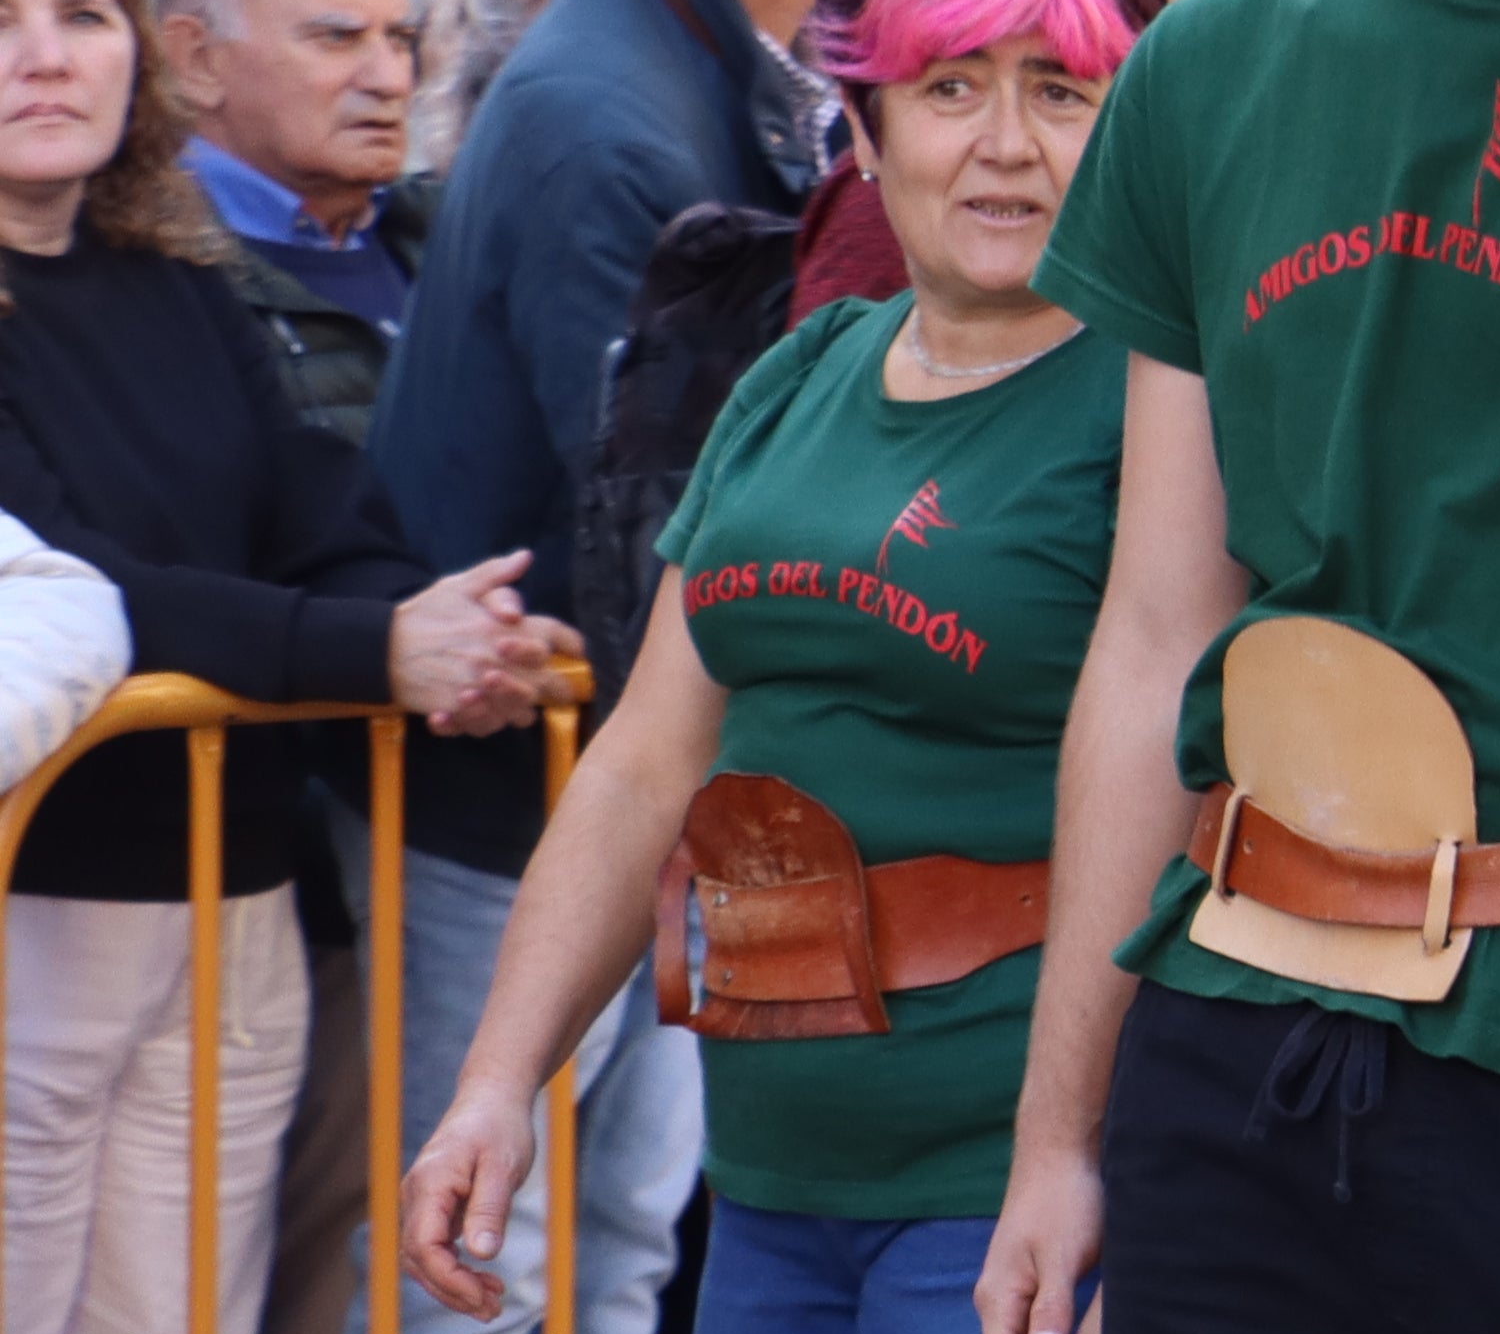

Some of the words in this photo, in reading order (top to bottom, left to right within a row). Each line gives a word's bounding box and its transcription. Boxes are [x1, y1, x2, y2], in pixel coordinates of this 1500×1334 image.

[1244, 224, 1370, 334] AMIGOS
[768, 561, 827, 599] DEL
[837, 566, 988, 675] PENDÓN
